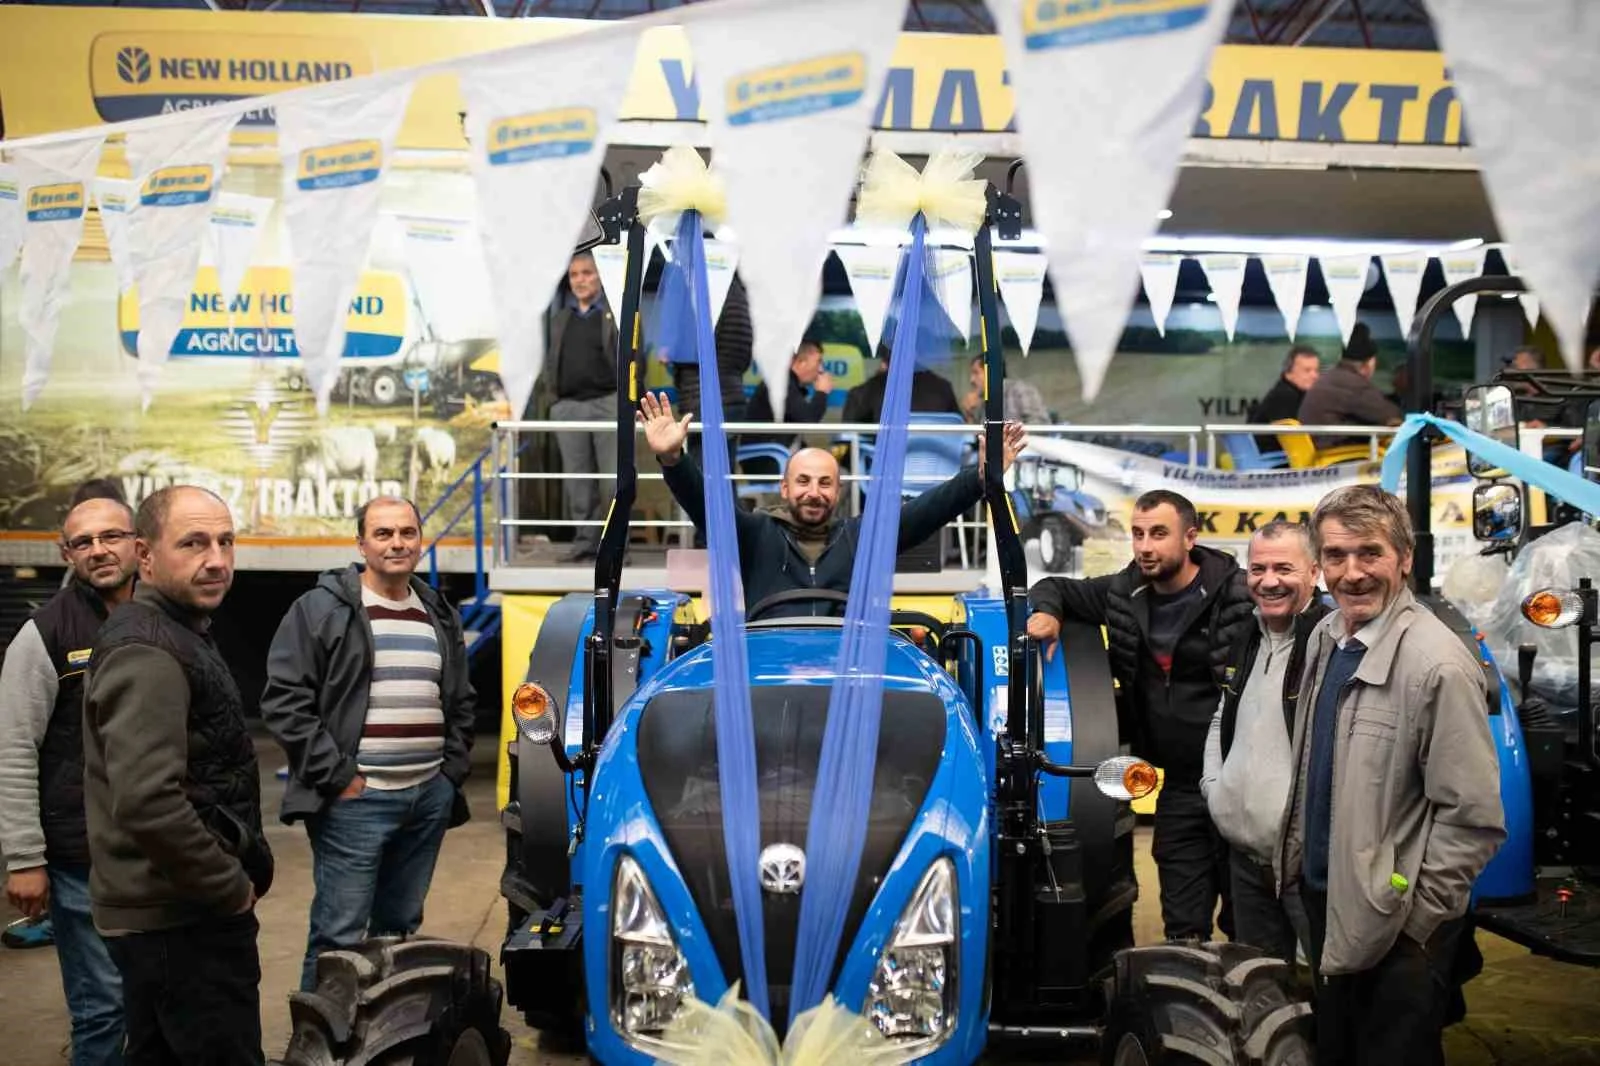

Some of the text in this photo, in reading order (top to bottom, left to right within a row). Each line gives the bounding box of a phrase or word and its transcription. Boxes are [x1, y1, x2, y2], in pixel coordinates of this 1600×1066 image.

[160, 57, 353, 83] NEW HOLLAND
[190, 293, 250, 313] NEW
[187, 330, 298, 353] AGRICULT
